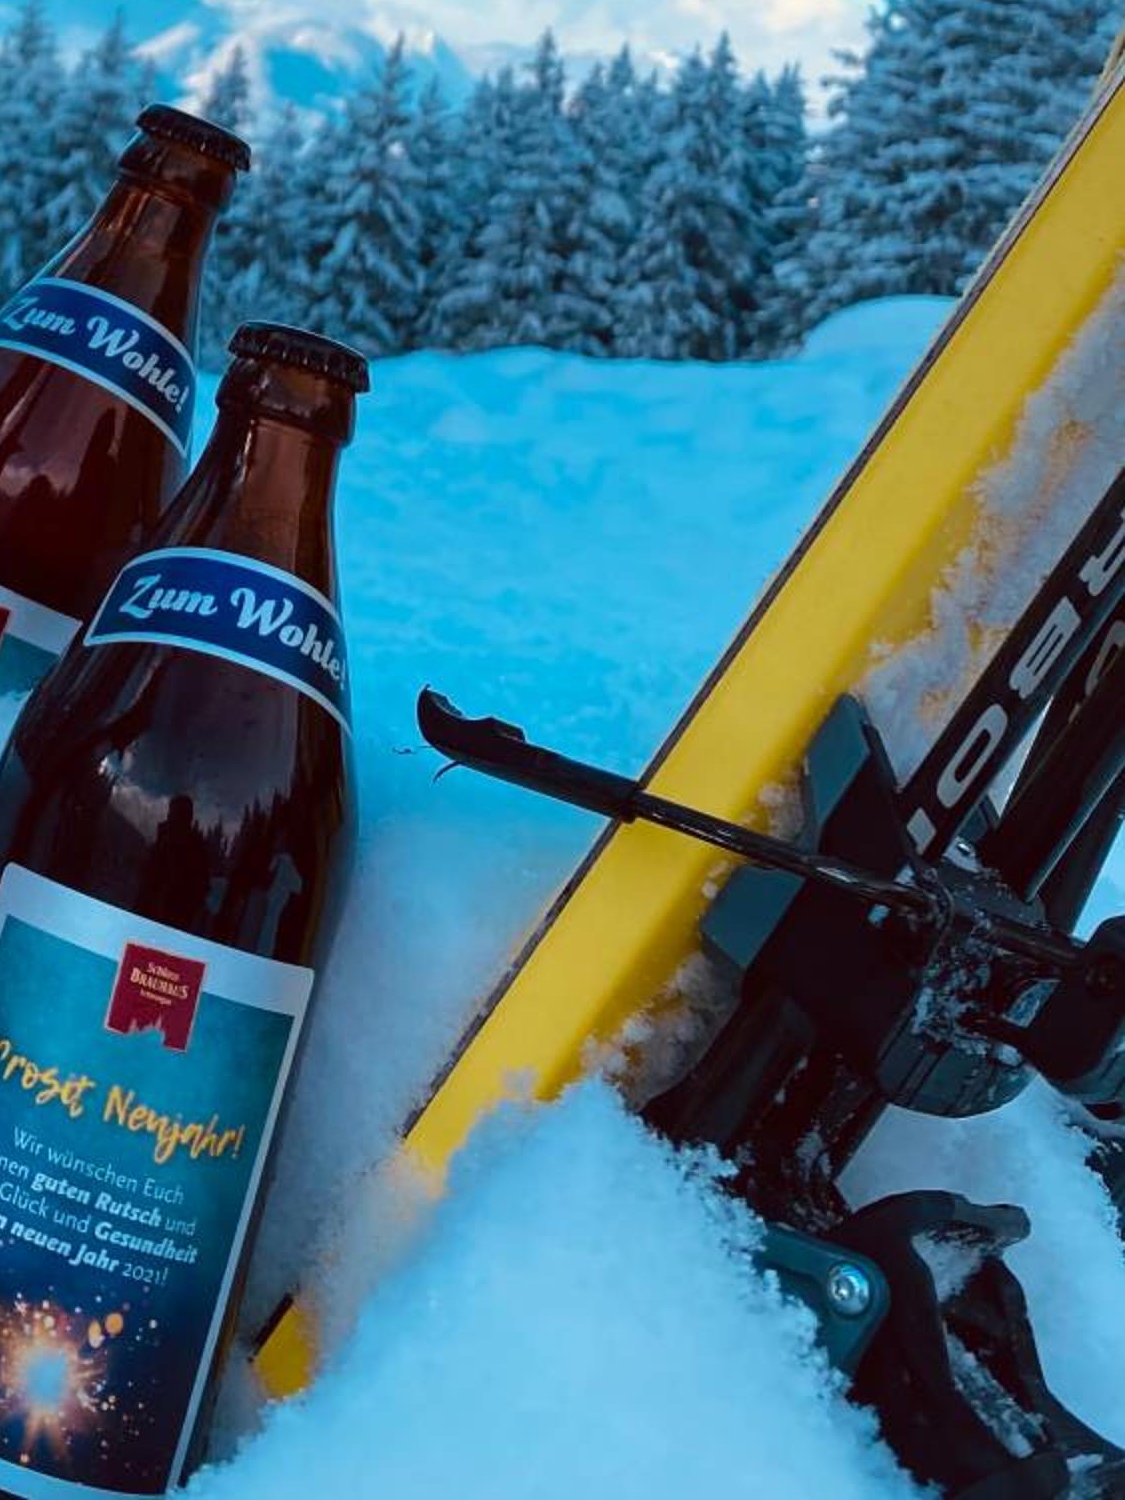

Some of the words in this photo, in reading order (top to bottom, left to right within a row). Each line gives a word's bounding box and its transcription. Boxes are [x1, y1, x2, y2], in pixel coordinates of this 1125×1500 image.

[2, 296, 76, 337] Zum
[86, 315, 190, 414] Wohle!
[119, 574, 218, 620] Zum
[230, 586, 347, 691] Wohle!
[102, 1083, 246, 1165] Neujahr!
[13, 1125, 43, 1157] Wir
[48, 1144, 138, 1194] wünschen
[143, 1177, 185, 1206] Euch
[33, 1171, 90, 1206] guten
[95, 1192, 162, 1228] Rutsch
[165, 1211, 197, 1236] und
[10, 1221, 71, 1258] neuen
[68, 1240, 120, 1274] Jahr
[122, 1265, 170, 1286] 2021!
[53, 1204, 89, 1233] und
[94, 1220, 199, 1265] Gesundheit
